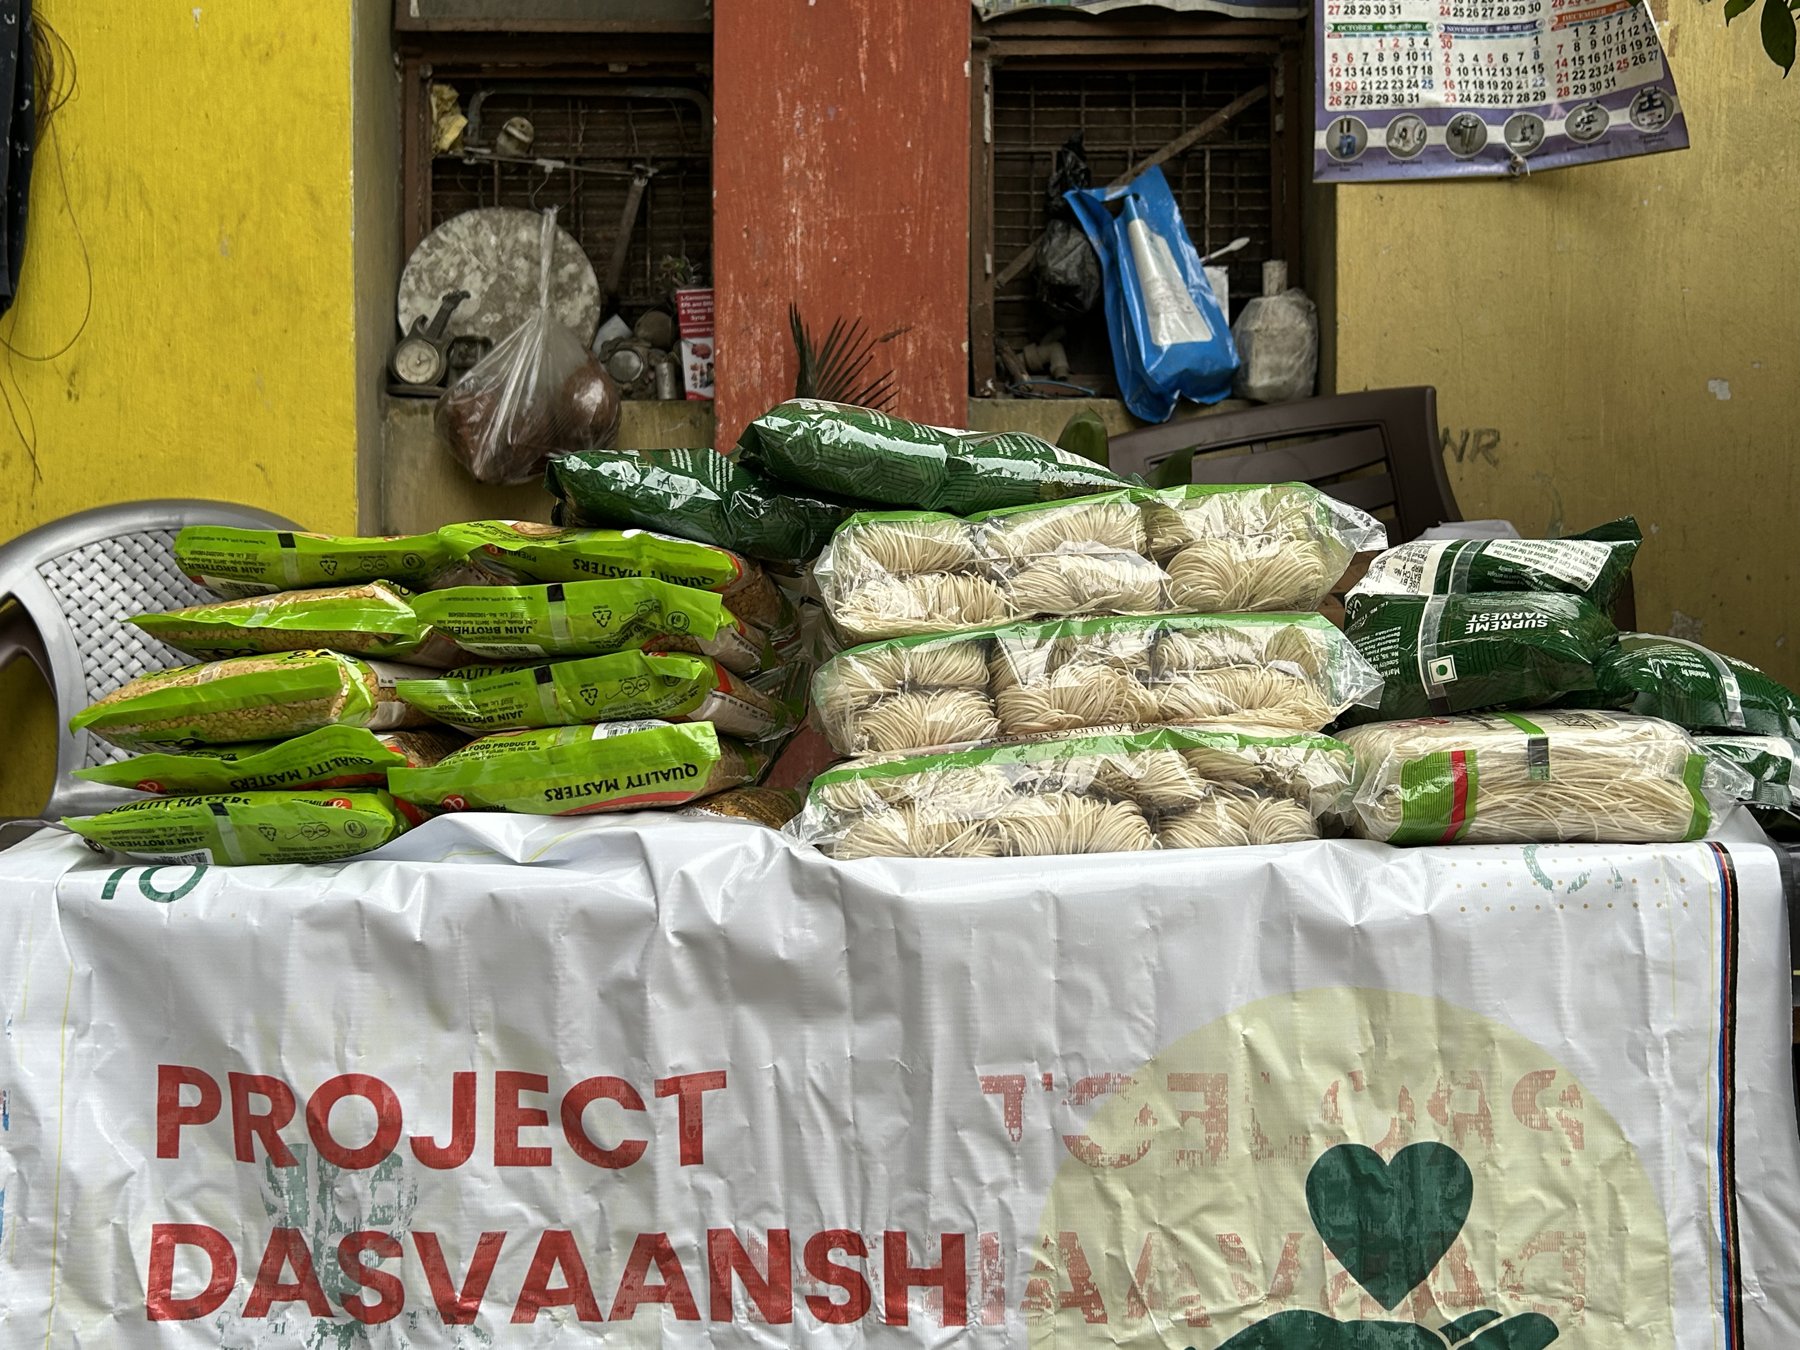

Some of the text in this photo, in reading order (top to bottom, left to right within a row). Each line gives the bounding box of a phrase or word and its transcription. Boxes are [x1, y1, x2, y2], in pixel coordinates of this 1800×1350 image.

[1328, 5, 1401, 15] 27 28 29 30 31
[1440, 3, 1541, 17] 24 25 26 27 28 29 30
[1574, 12, 1637, 37] 1 2 3 4 5
[1379, 38, 1429, 47] 1 2 3 4
[1441, 36, 1538, 49] 30 1
[1557, 21, 1654, 54] 7 8 9 10 11 12 13
[1332, 52, 1432, 62] 5 6 7 8 9 10 11
[1444, 50, 1539, 63] 2 3 4 5 6 7 8
[1555, 36, 1657, 69] 14 15 16 17 18 19 20
[1329, 66, 1433, 76] 12 13 14 15 16 17 18
[1445, 64, 1544, 77] 9 10 11 12 13 14 15
[1556, 50, 1658, 83] 21 22 23 24 25 26 27
[1329, 80, 1433, 91] 19 20 21 22 23 24 25
[1444, 77, 1545, 90] 16 17 18 19 20 21 22
[1557, 77, 1616, 97] 28 29 30 31
[1329, 93, 1419, 105] 26 27 28 29 30 31
[1445, 91, 1545, 103] 23 24 25 26 27 28 29
[572, 558, 642, 579] MASTERS
[1467, 612, 1548, 622] HARVEST
[505, 626, 533, 634] JAIN
[1464, 619, 1548, 634] SUPREME
[497, 710, 523, 722] JAIN
[493, 740, 536, 748] PRODUCTS
[229, 755, 374, 791] QUALITY MASTERS
[544, 763, 699, 802] QUALITY MASTERS
[109, 835, 205, 848] JAIN BROTHERS
[155, 1064, 727, 1169] PROJECT
[146, 1222, 968, 1328] DASVAANSH
